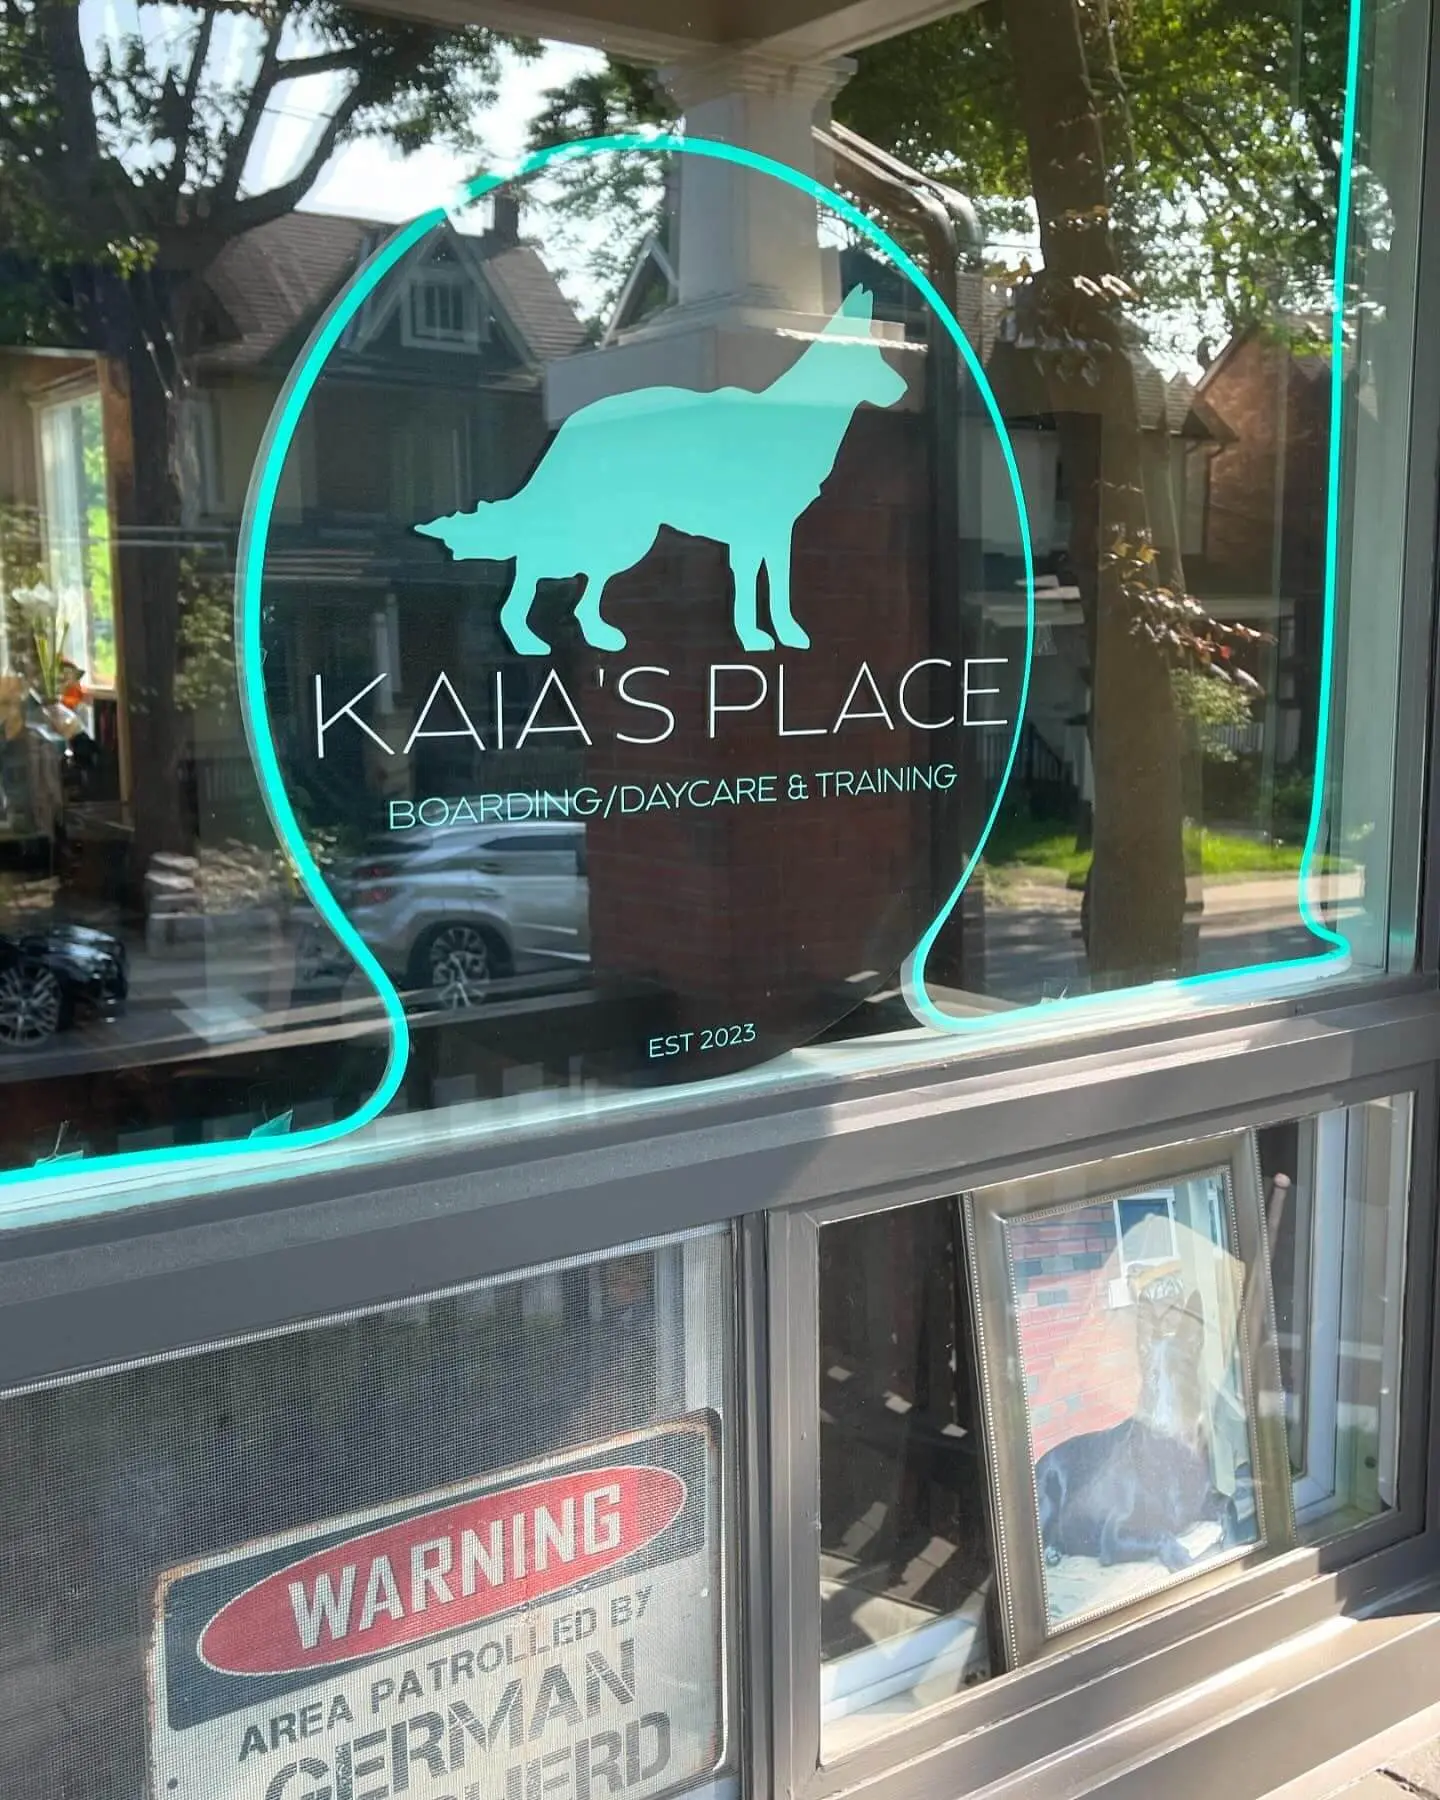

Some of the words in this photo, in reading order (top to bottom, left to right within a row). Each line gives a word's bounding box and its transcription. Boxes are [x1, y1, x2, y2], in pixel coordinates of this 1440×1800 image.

[315, 665, 675, 759] KAIA'S
[709, 658, 1009, 739] PLACE
[389, 775, 778, 830] BOARDING/DAYCARE
[787, 774, 809, 801] &
[815, 763, 957, 798] TRAINING
[649, 1032, 694, 1058] EST
[700, 1022, 756, 1050] 2023
[287, 1482, 622, 1651] WARNING
[239, 1695, 354, 1762] AREA
[371, 1607, 597, 1714] PATROLLED
[611, 1585, 653, 1624] BY
[265, 1638, 635, 1800] GERMAN
